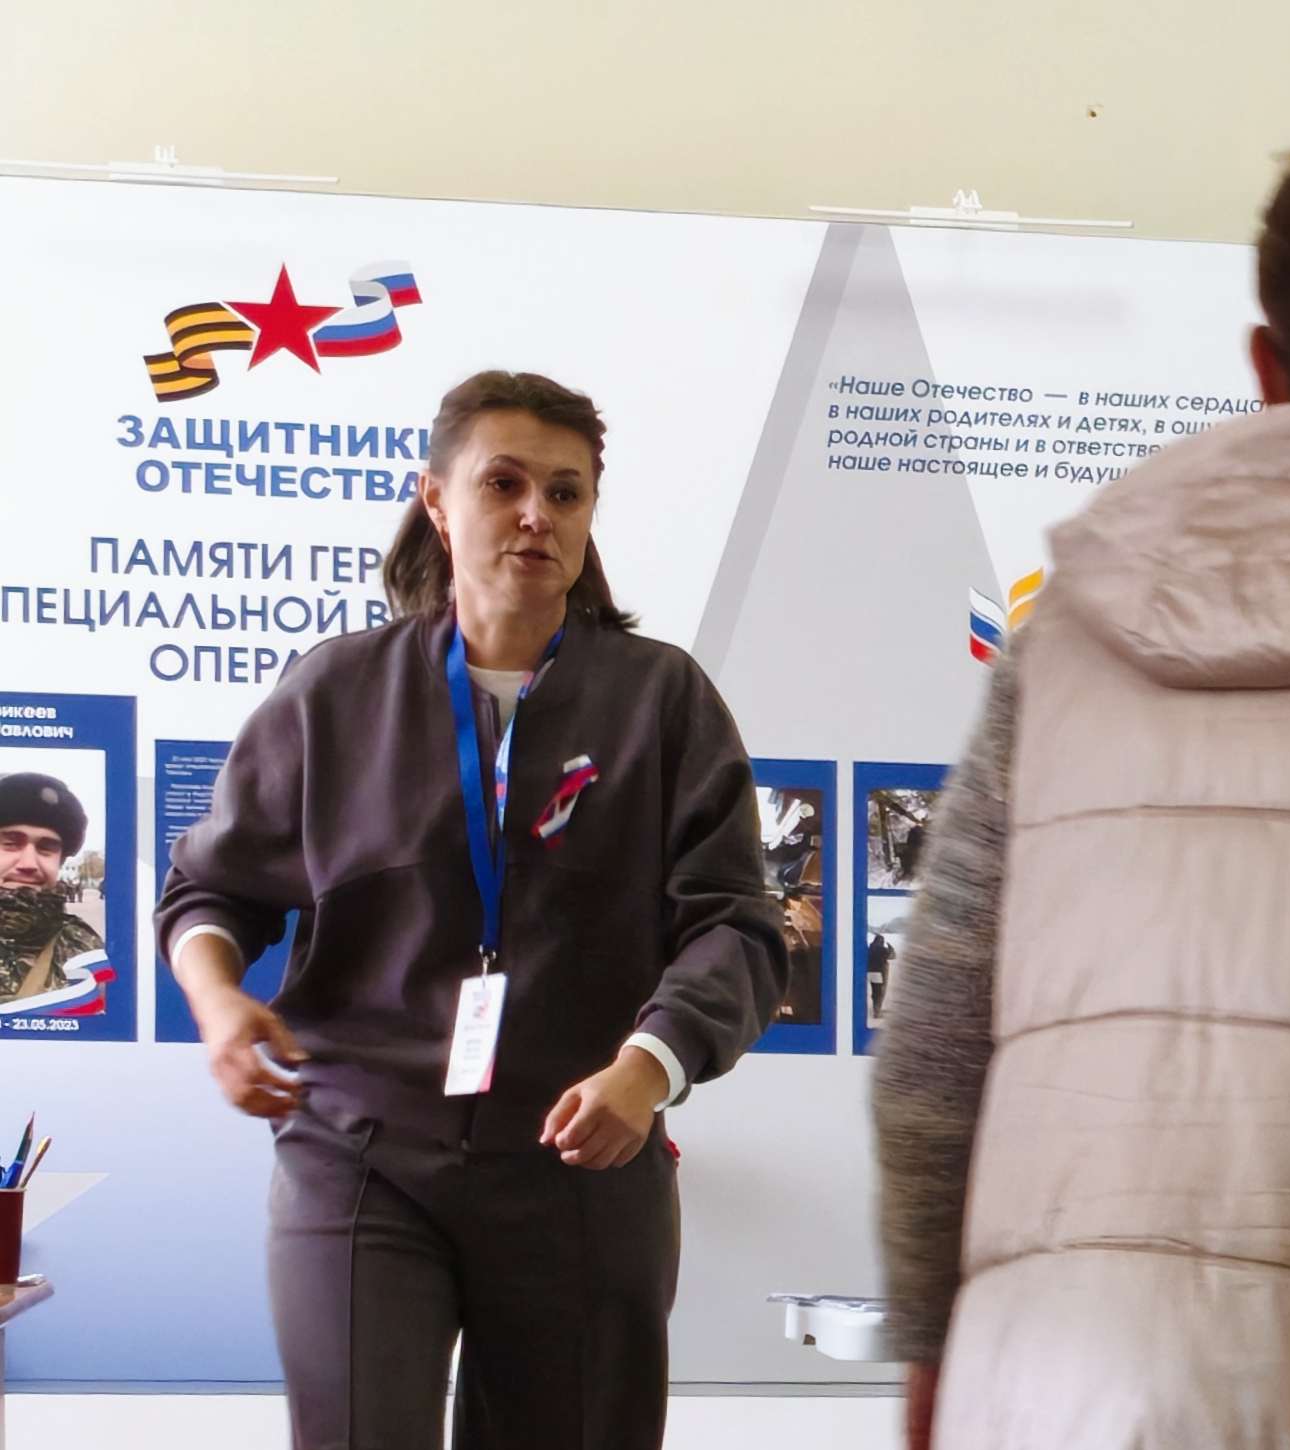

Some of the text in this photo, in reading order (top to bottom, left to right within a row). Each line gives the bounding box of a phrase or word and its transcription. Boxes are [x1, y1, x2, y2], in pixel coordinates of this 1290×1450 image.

[829, 375, 905, 396] «Наше
[911, 379, 1033, 403] Отечество
[1078, 391, 1090, 405] в
[1095, 392, 1170, 409] наших
[1175, 395, 1264, 415] сердца
[828, 404, 840, 418] в
[846, 405, 922, 422] наших
[927, 408, 1052, 428] родителях
[1057, 415, 1071, 429] и
[1075, 416, 1147, 435] детях,
[1154, 419, 1165, 433] в
[827, 428, 1168, 457] родной страны и в ответстве
[828, 455, 1128, 484] наше настоящее и будущ
[90, 537, 383, 583] ПАМЯТИ ГЕР
[0, 585, 347, 634] ПЕЦИАЛЬНОЙ
[0, 722, 74, 739] авлович
